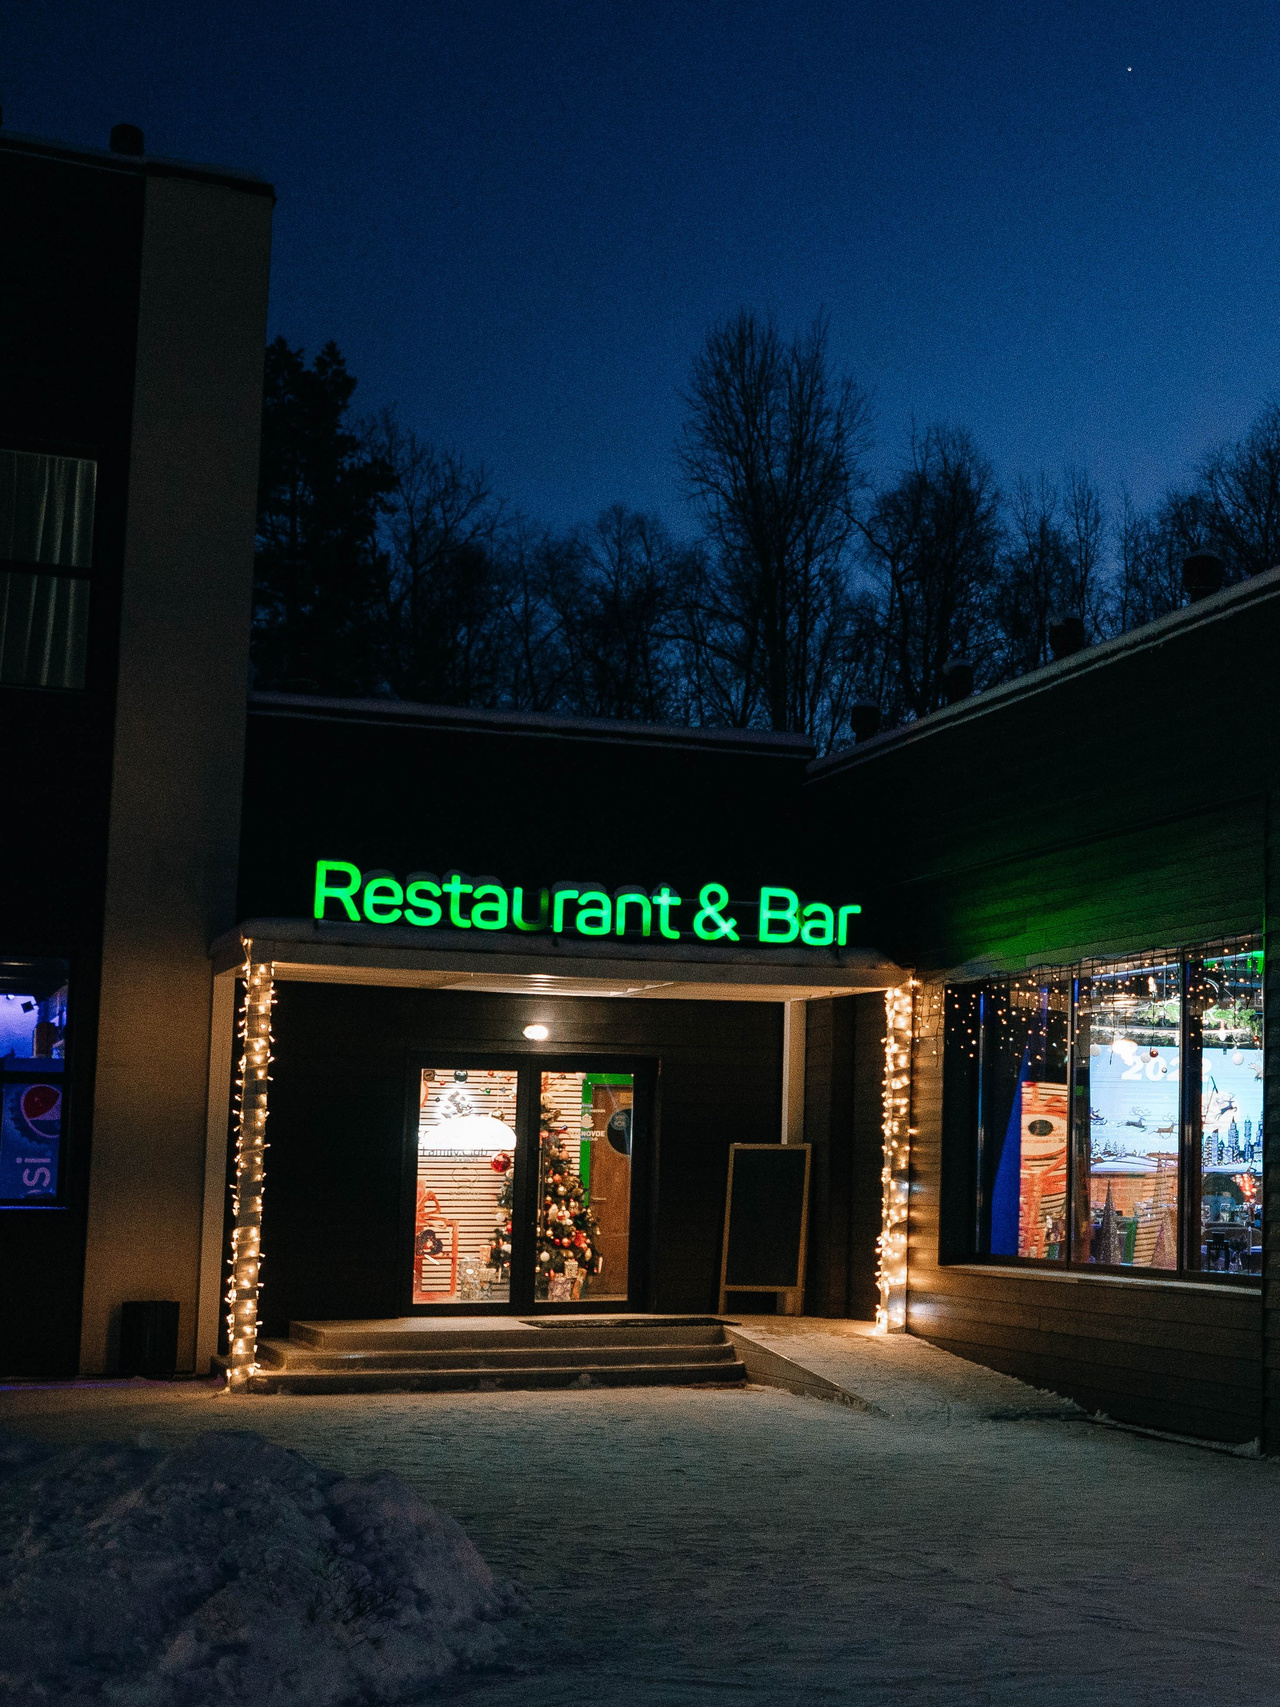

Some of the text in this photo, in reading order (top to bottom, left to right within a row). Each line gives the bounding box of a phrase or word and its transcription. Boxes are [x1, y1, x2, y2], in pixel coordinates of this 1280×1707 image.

[313, 860, 862, 946] Restaurant & Bar
[16, 1157, 51, 1194] si
